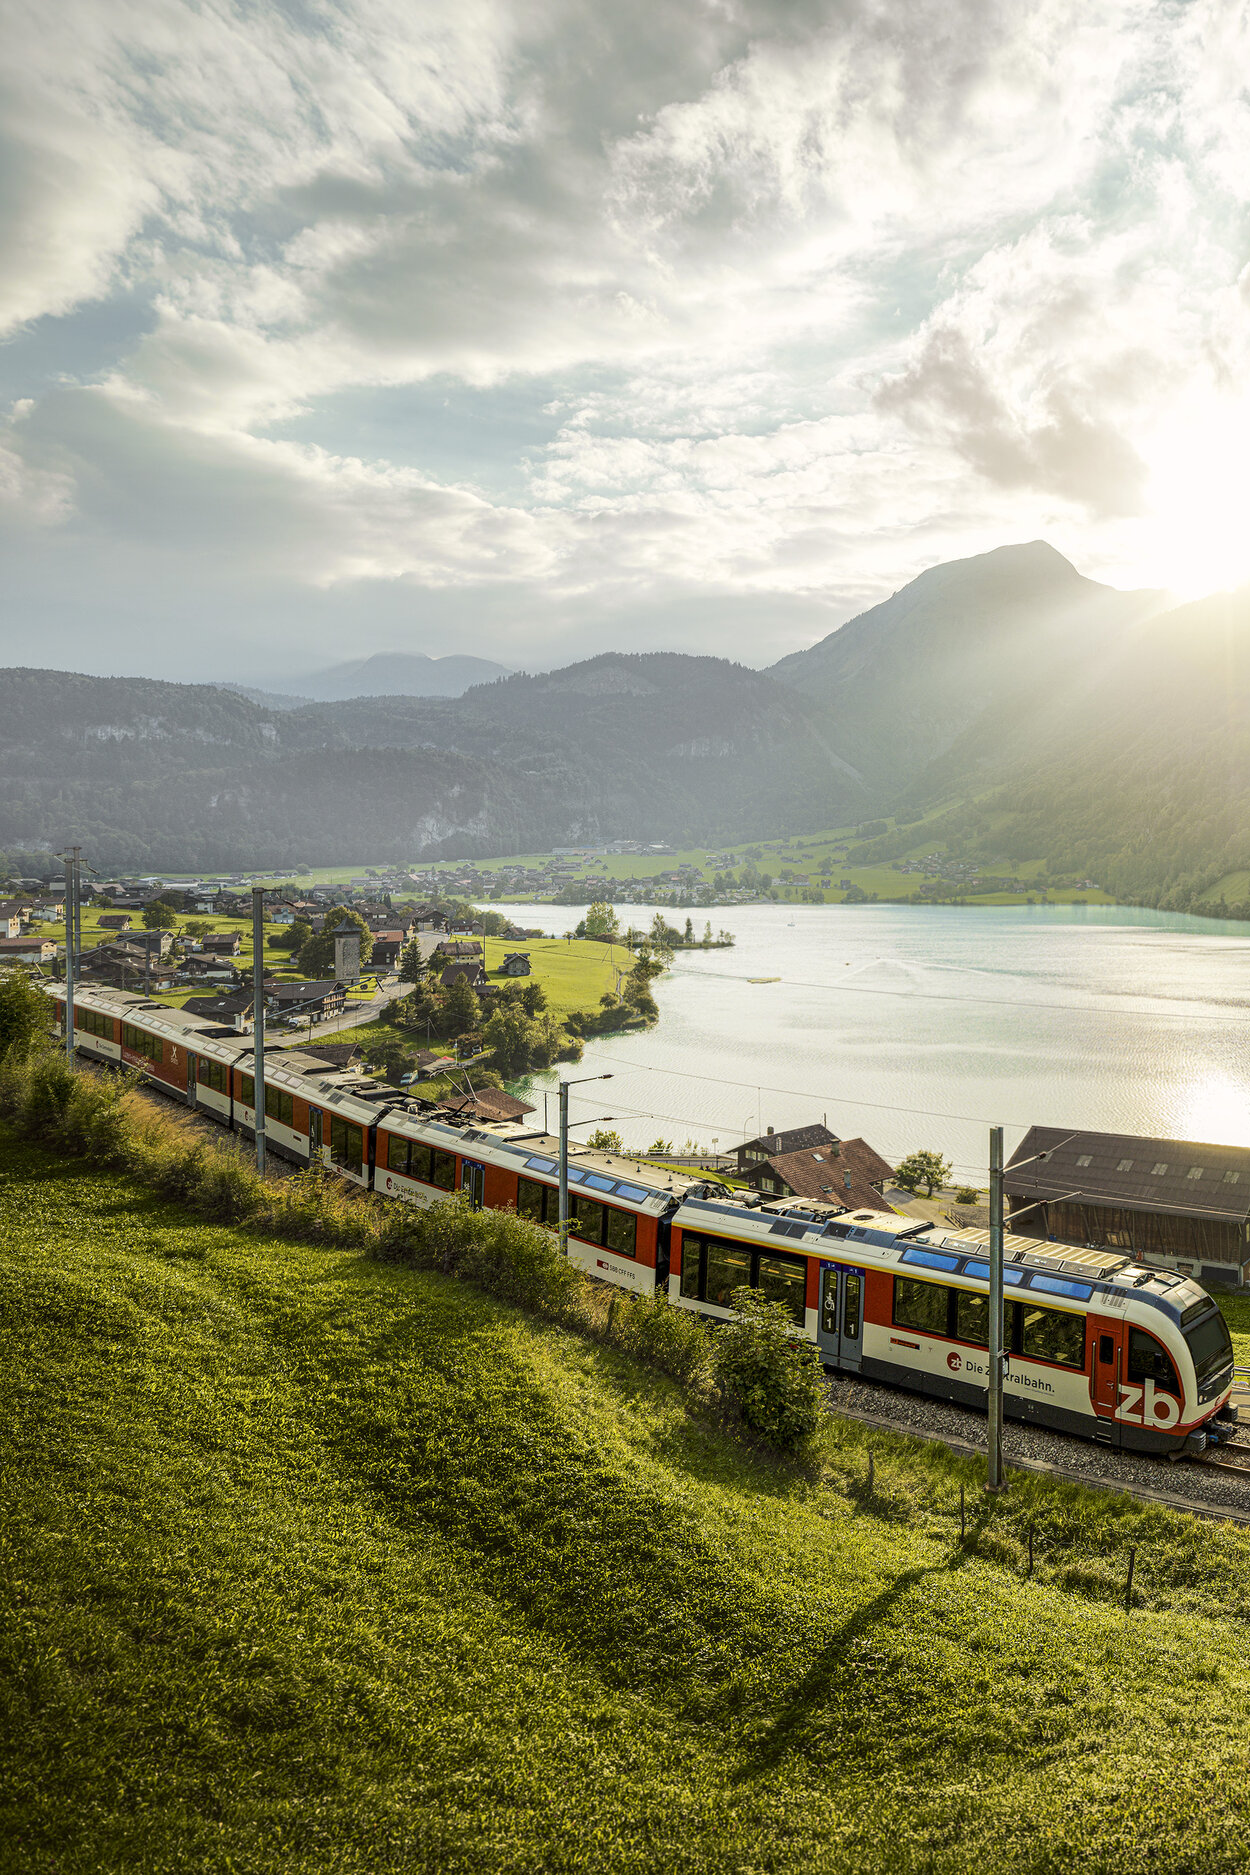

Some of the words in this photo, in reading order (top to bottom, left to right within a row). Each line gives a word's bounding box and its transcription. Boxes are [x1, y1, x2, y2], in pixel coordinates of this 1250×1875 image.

[826, 1317, 832, 1329] 1
[849, 1323, 855, 1335] 1
[966, 1361, 982, 1374] Die
[985, 1365, 1055, 1393] Ztralbahn.
[1114, 1378, 1180, 1430] zb
